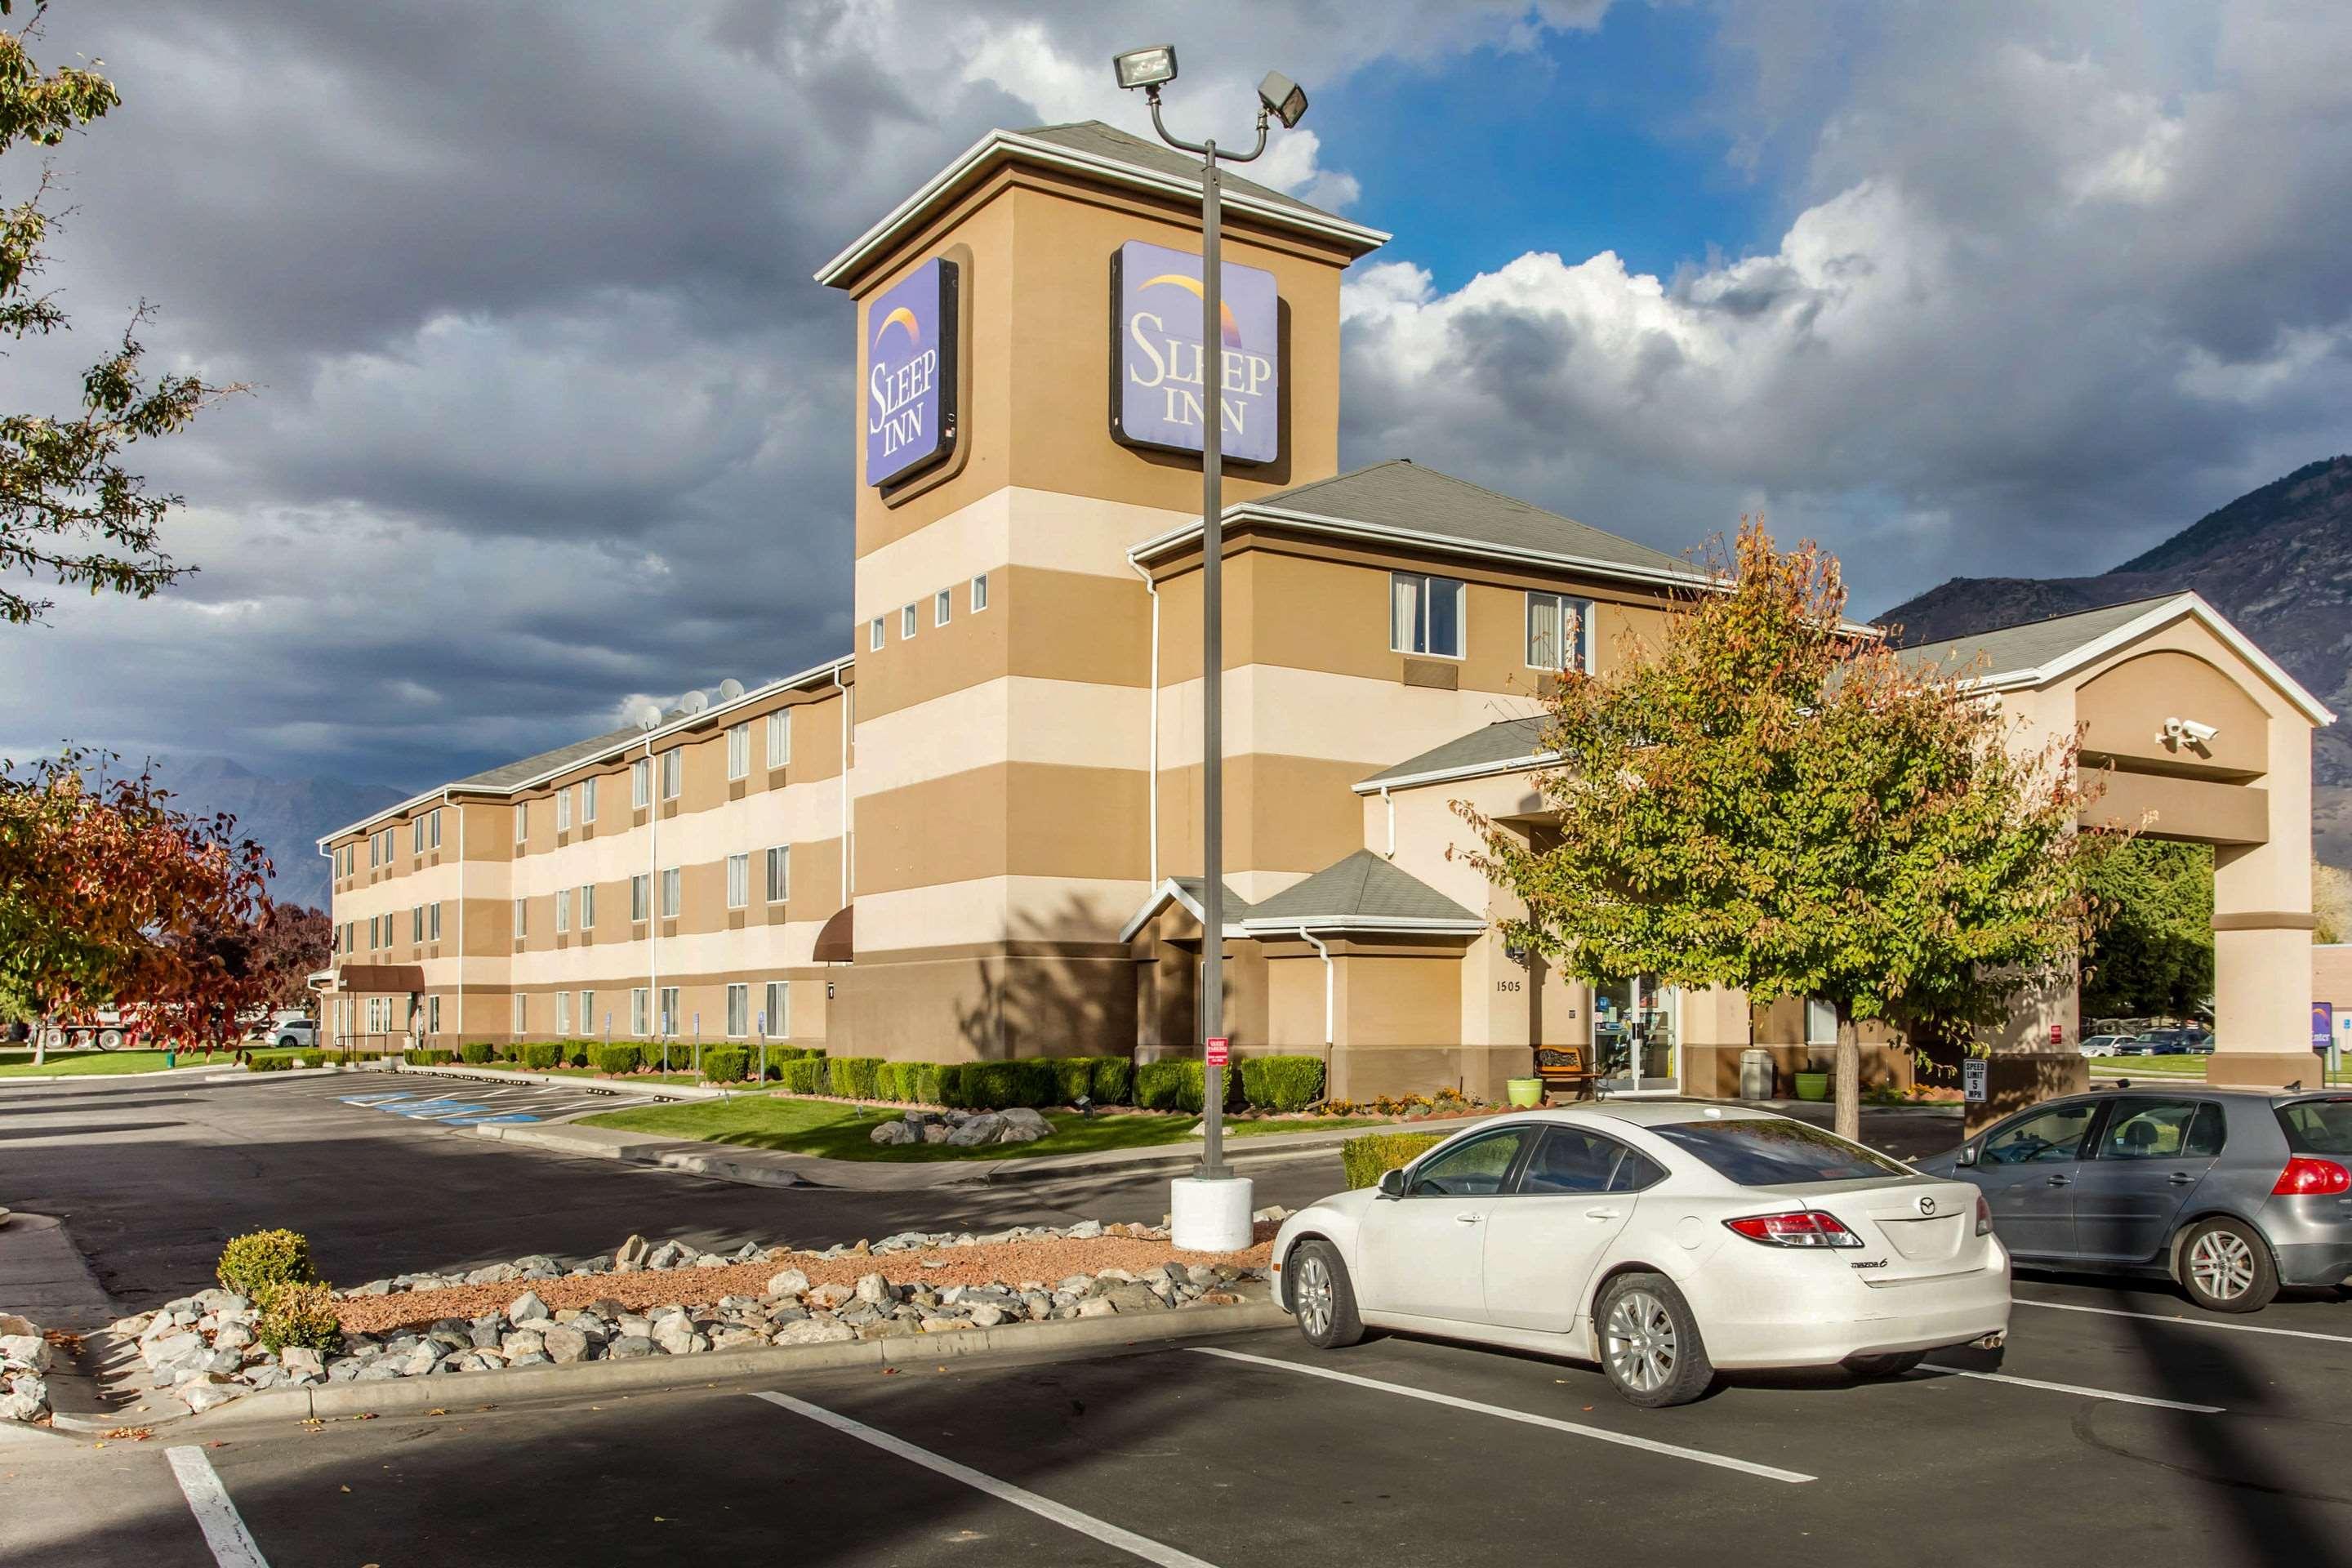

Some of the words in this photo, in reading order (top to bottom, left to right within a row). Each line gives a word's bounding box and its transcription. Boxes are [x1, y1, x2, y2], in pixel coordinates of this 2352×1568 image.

[870, 349, 936, 434] SLEEP
[1163, 386, 1248, 435] INN
[883, 402, 924, 457] INN
[1497, 981, 1521, 992] 1505
[1969, 1090, 1981, 1098] MPH
[1973, 1080, 1978, 1089] 5
